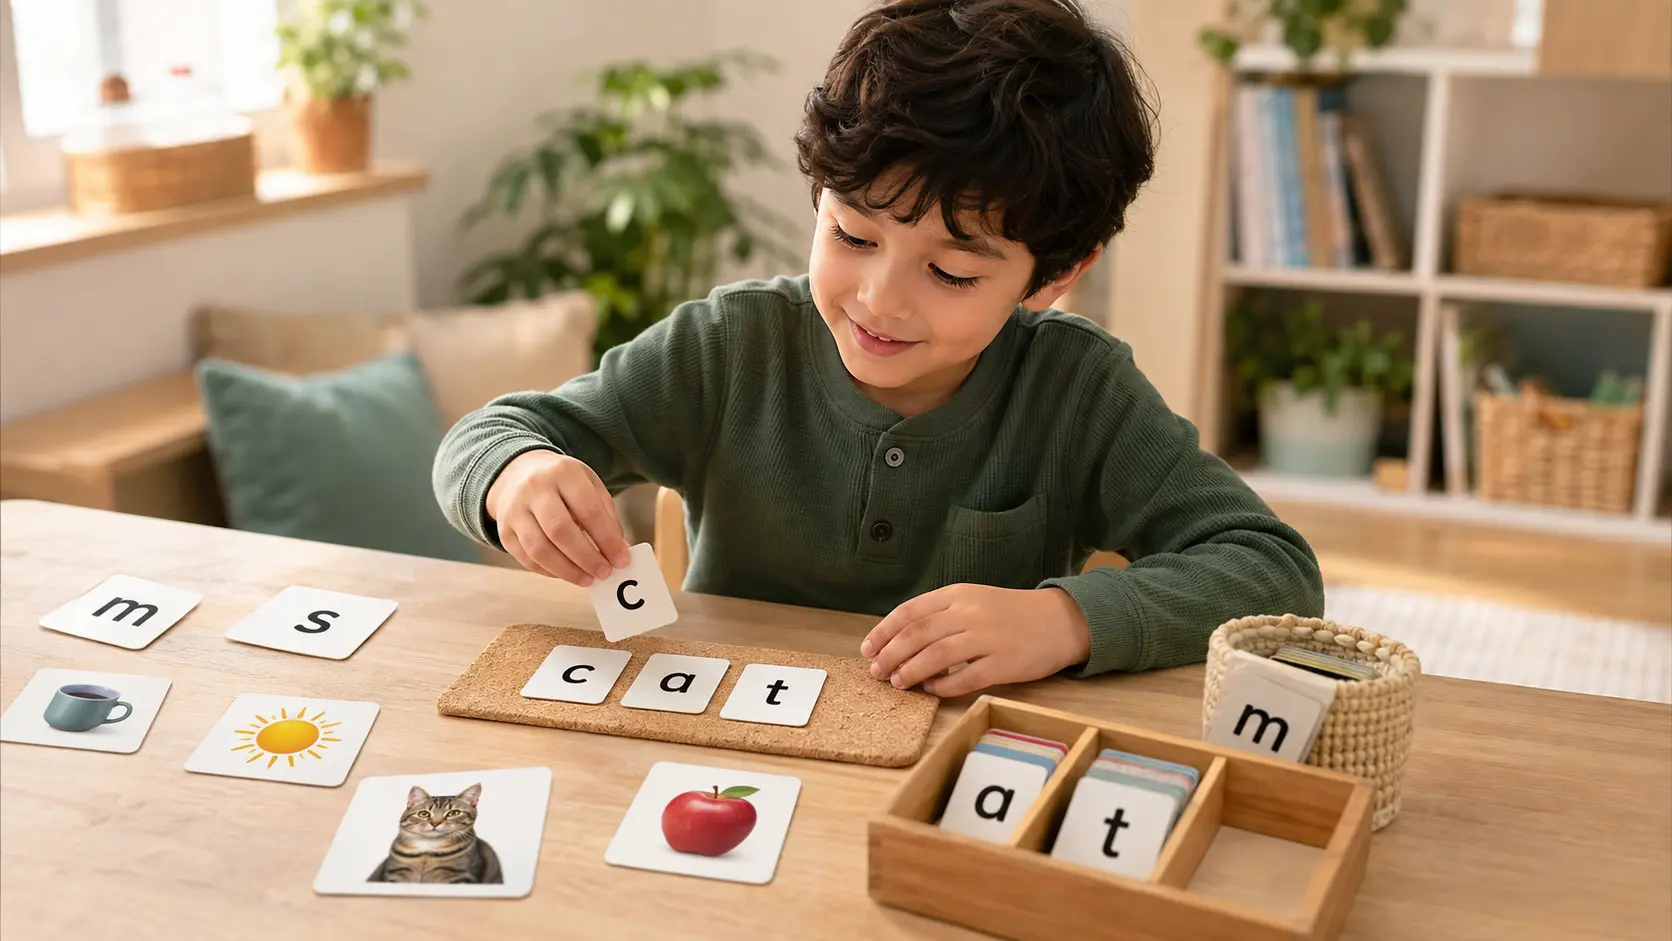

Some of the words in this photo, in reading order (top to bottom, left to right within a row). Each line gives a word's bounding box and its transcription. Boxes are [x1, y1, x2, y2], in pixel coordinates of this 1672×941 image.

[92, 597, 159, 627] m
[616, 579, 645, 611] c
[293, 610, 340, 634] s
[659, 672, 697, 694] a
[765, 679, 789, 706] t
[1232, 703, 1290, 754] m
[974, 785, 1015, 823] a
[1102, 808, 1130, 858] t
